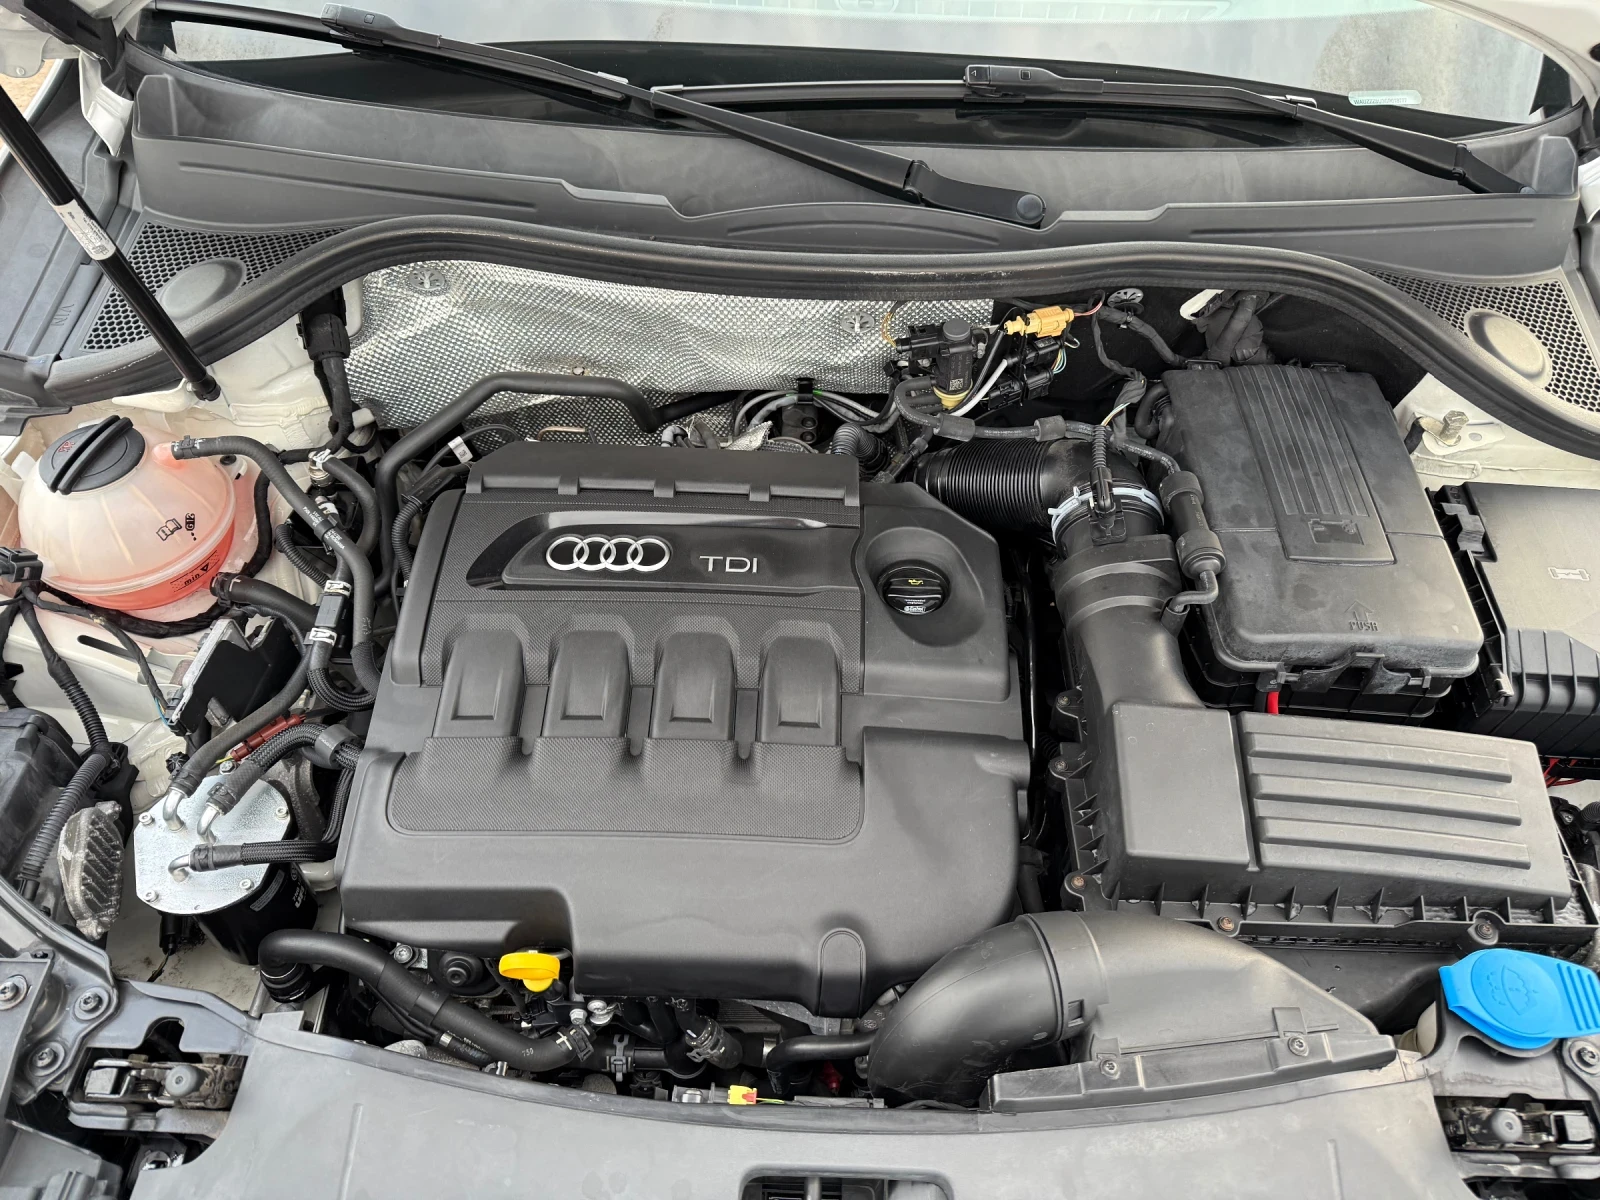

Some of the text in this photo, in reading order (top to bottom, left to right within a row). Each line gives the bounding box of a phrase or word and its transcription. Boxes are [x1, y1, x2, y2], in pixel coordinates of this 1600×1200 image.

[185, 513, 196, 531] G12
[699, 555, 758, 573] TDI
[184, 573, 201, 586] min
[1349, 621, 1379, 632] PUSH
